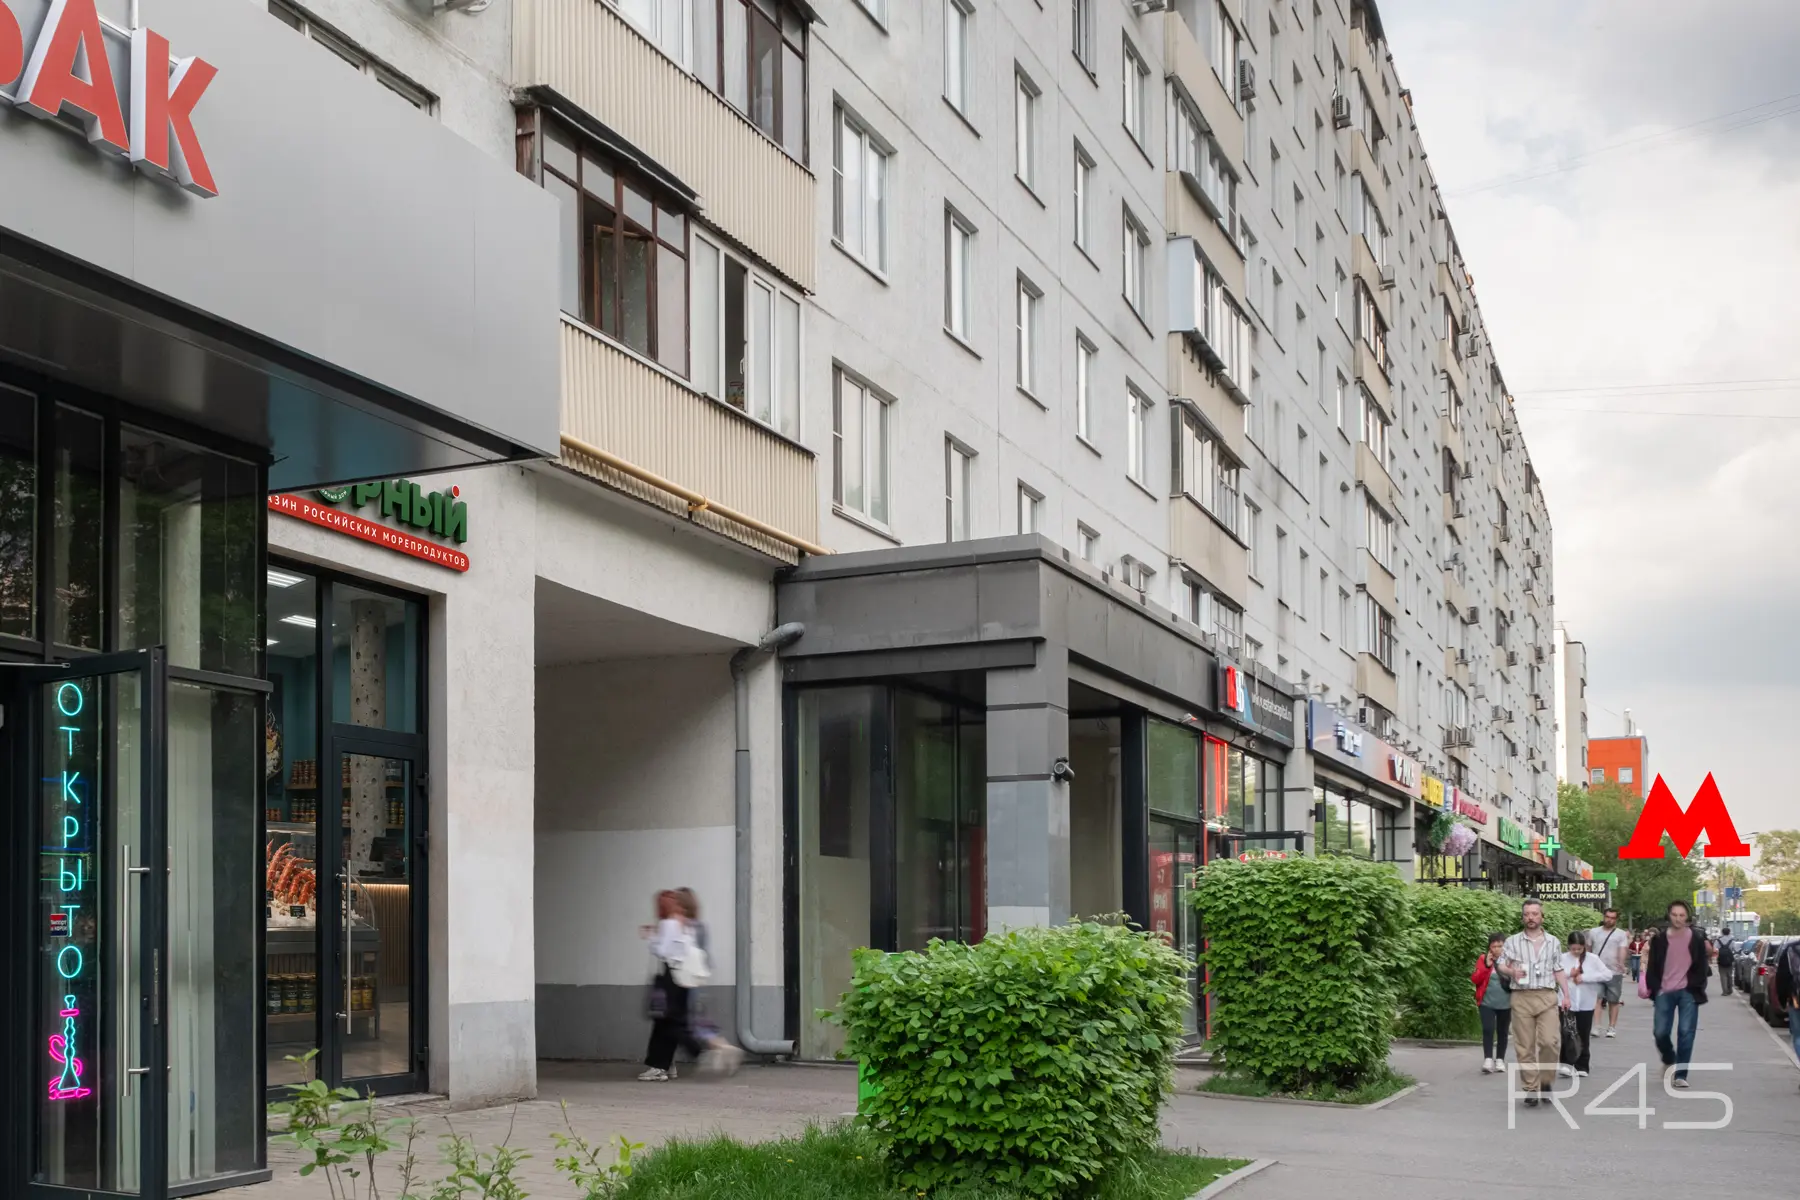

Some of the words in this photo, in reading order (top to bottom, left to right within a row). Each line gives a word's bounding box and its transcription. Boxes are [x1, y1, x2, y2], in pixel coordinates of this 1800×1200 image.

[304, 505, 377, 538] РОССИЙСКИХ
[382, 531, 465, 567] МОРЕПРОДУКТОВ
[57, 682, 83, 979] ОТКРЫТО
[1536, 882, 1606, 893] МЕНДЕЛЕЕВ
[1570, 892, 1606, 900] СТРИЖКИ
